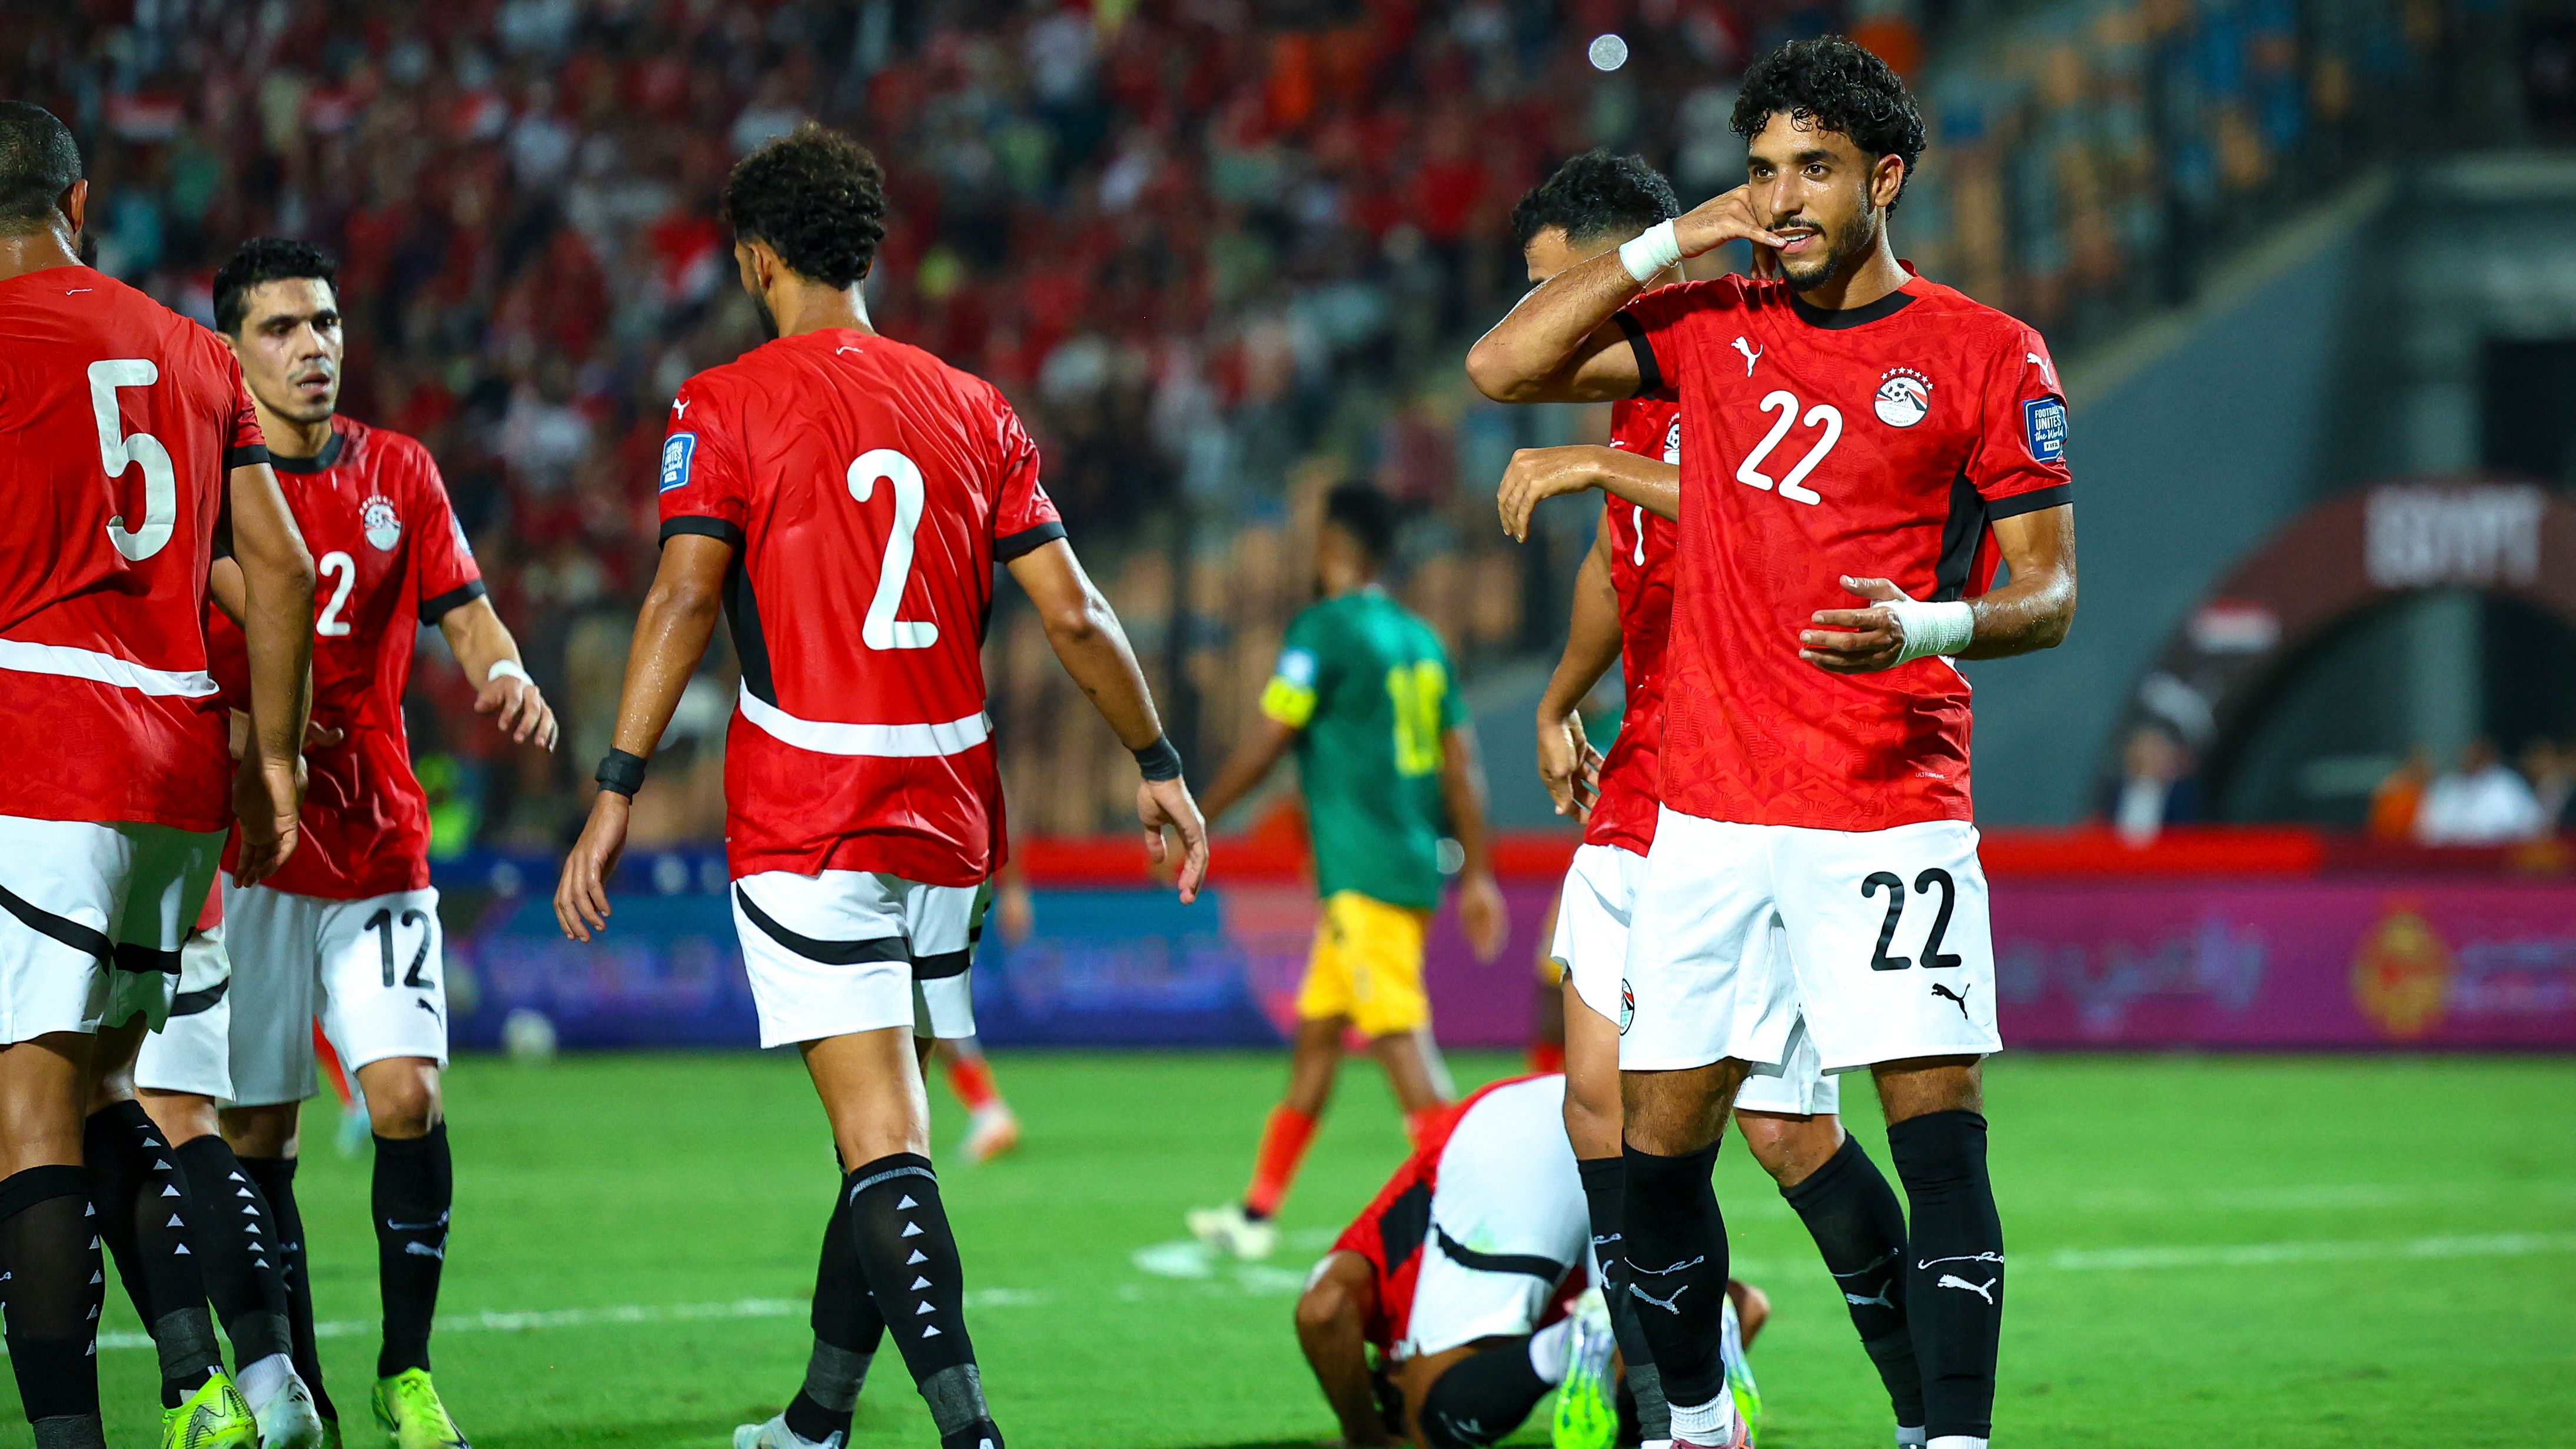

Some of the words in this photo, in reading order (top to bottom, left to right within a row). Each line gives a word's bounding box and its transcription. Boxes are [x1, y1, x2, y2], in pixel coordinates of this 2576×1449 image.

[1736, 390, 1843, 506] 22
[2035, 406, 2059, 418] FOOTBALL
[2035, 414, 2061, 430] UNITES
[2035, 430, 2047, 441] the
[2047, 426, 2063, 439] World
[88, 359, 176, 561] 5
[316, 551, 355, 636] 2
[847, 448, 939, 650] 2
[1387, 659, 1445, 777] 10
[364, 908, 435, 989] 12
[1861, 868, 1962, 971] 22
